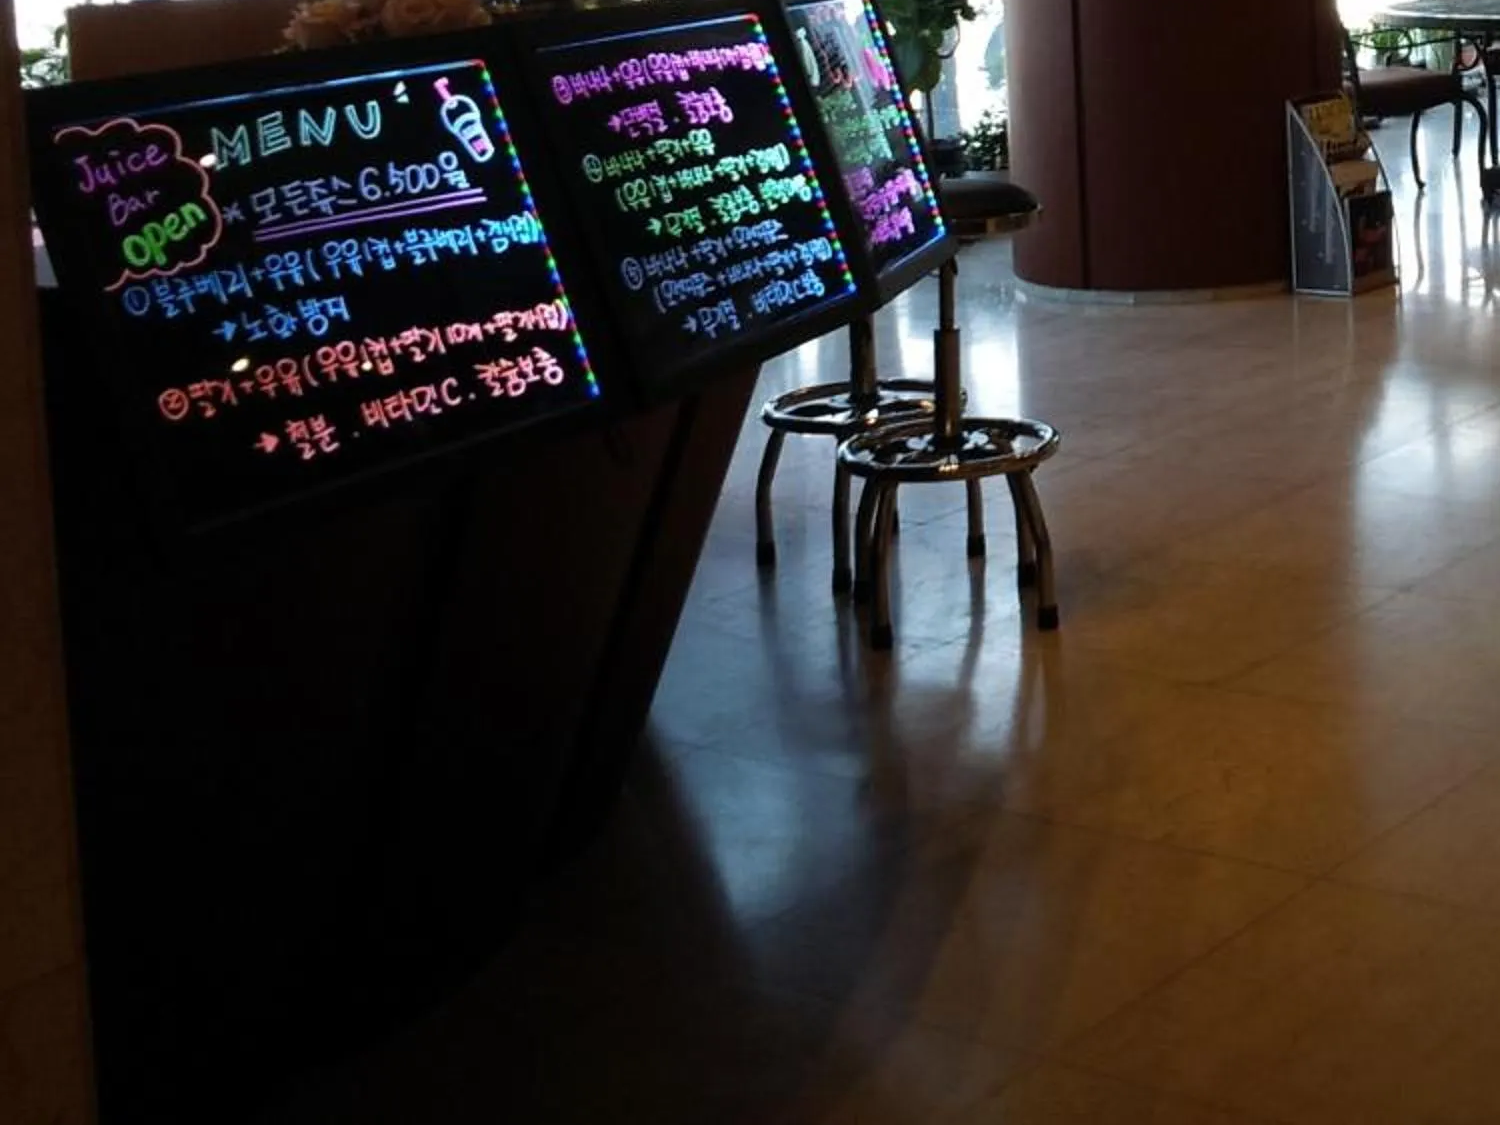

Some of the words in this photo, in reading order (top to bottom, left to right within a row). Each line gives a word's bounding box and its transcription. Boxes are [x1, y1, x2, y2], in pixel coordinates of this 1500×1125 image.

[211, 100, 381, 170] MENU
[74, 144, 168, 193] Juice
[107, 188, 161, 226] Bar
